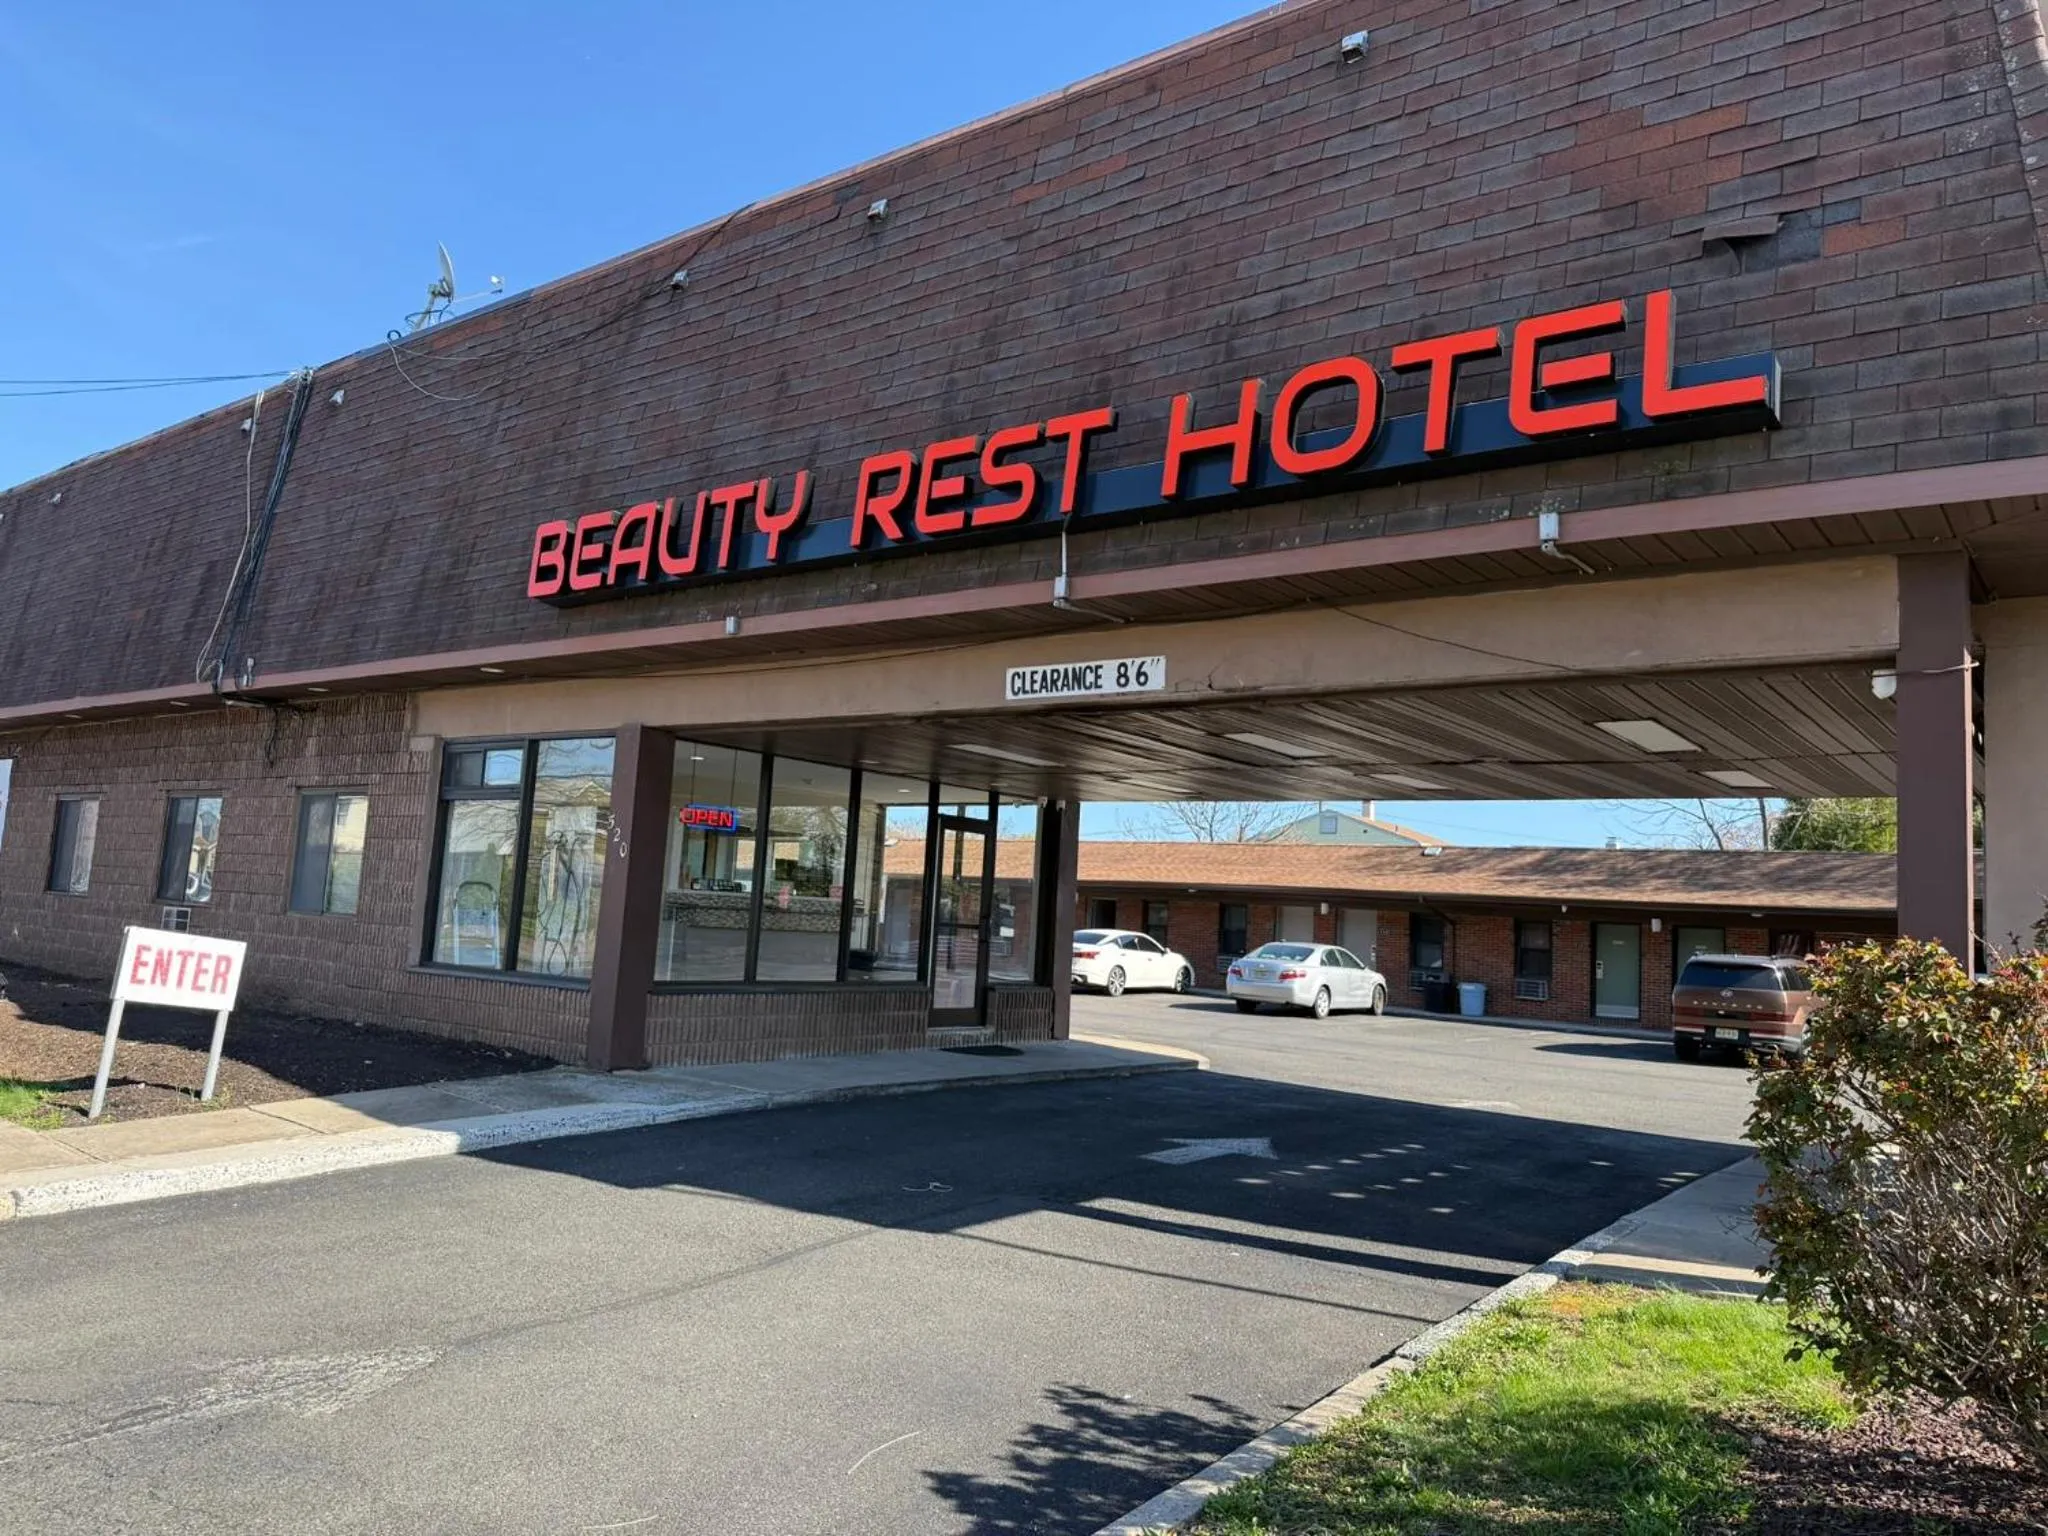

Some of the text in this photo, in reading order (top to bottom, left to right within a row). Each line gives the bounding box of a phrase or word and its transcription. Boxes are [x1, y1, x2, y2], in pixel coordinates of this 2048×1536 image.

[527, 289, 1768, 598] BEAUTY REST HOTEL
[1011, 664, 1103, 697] CLEARANCE
[680, 807, 733, 827] OPEN
[130, 944, 233, 994] ENTER
